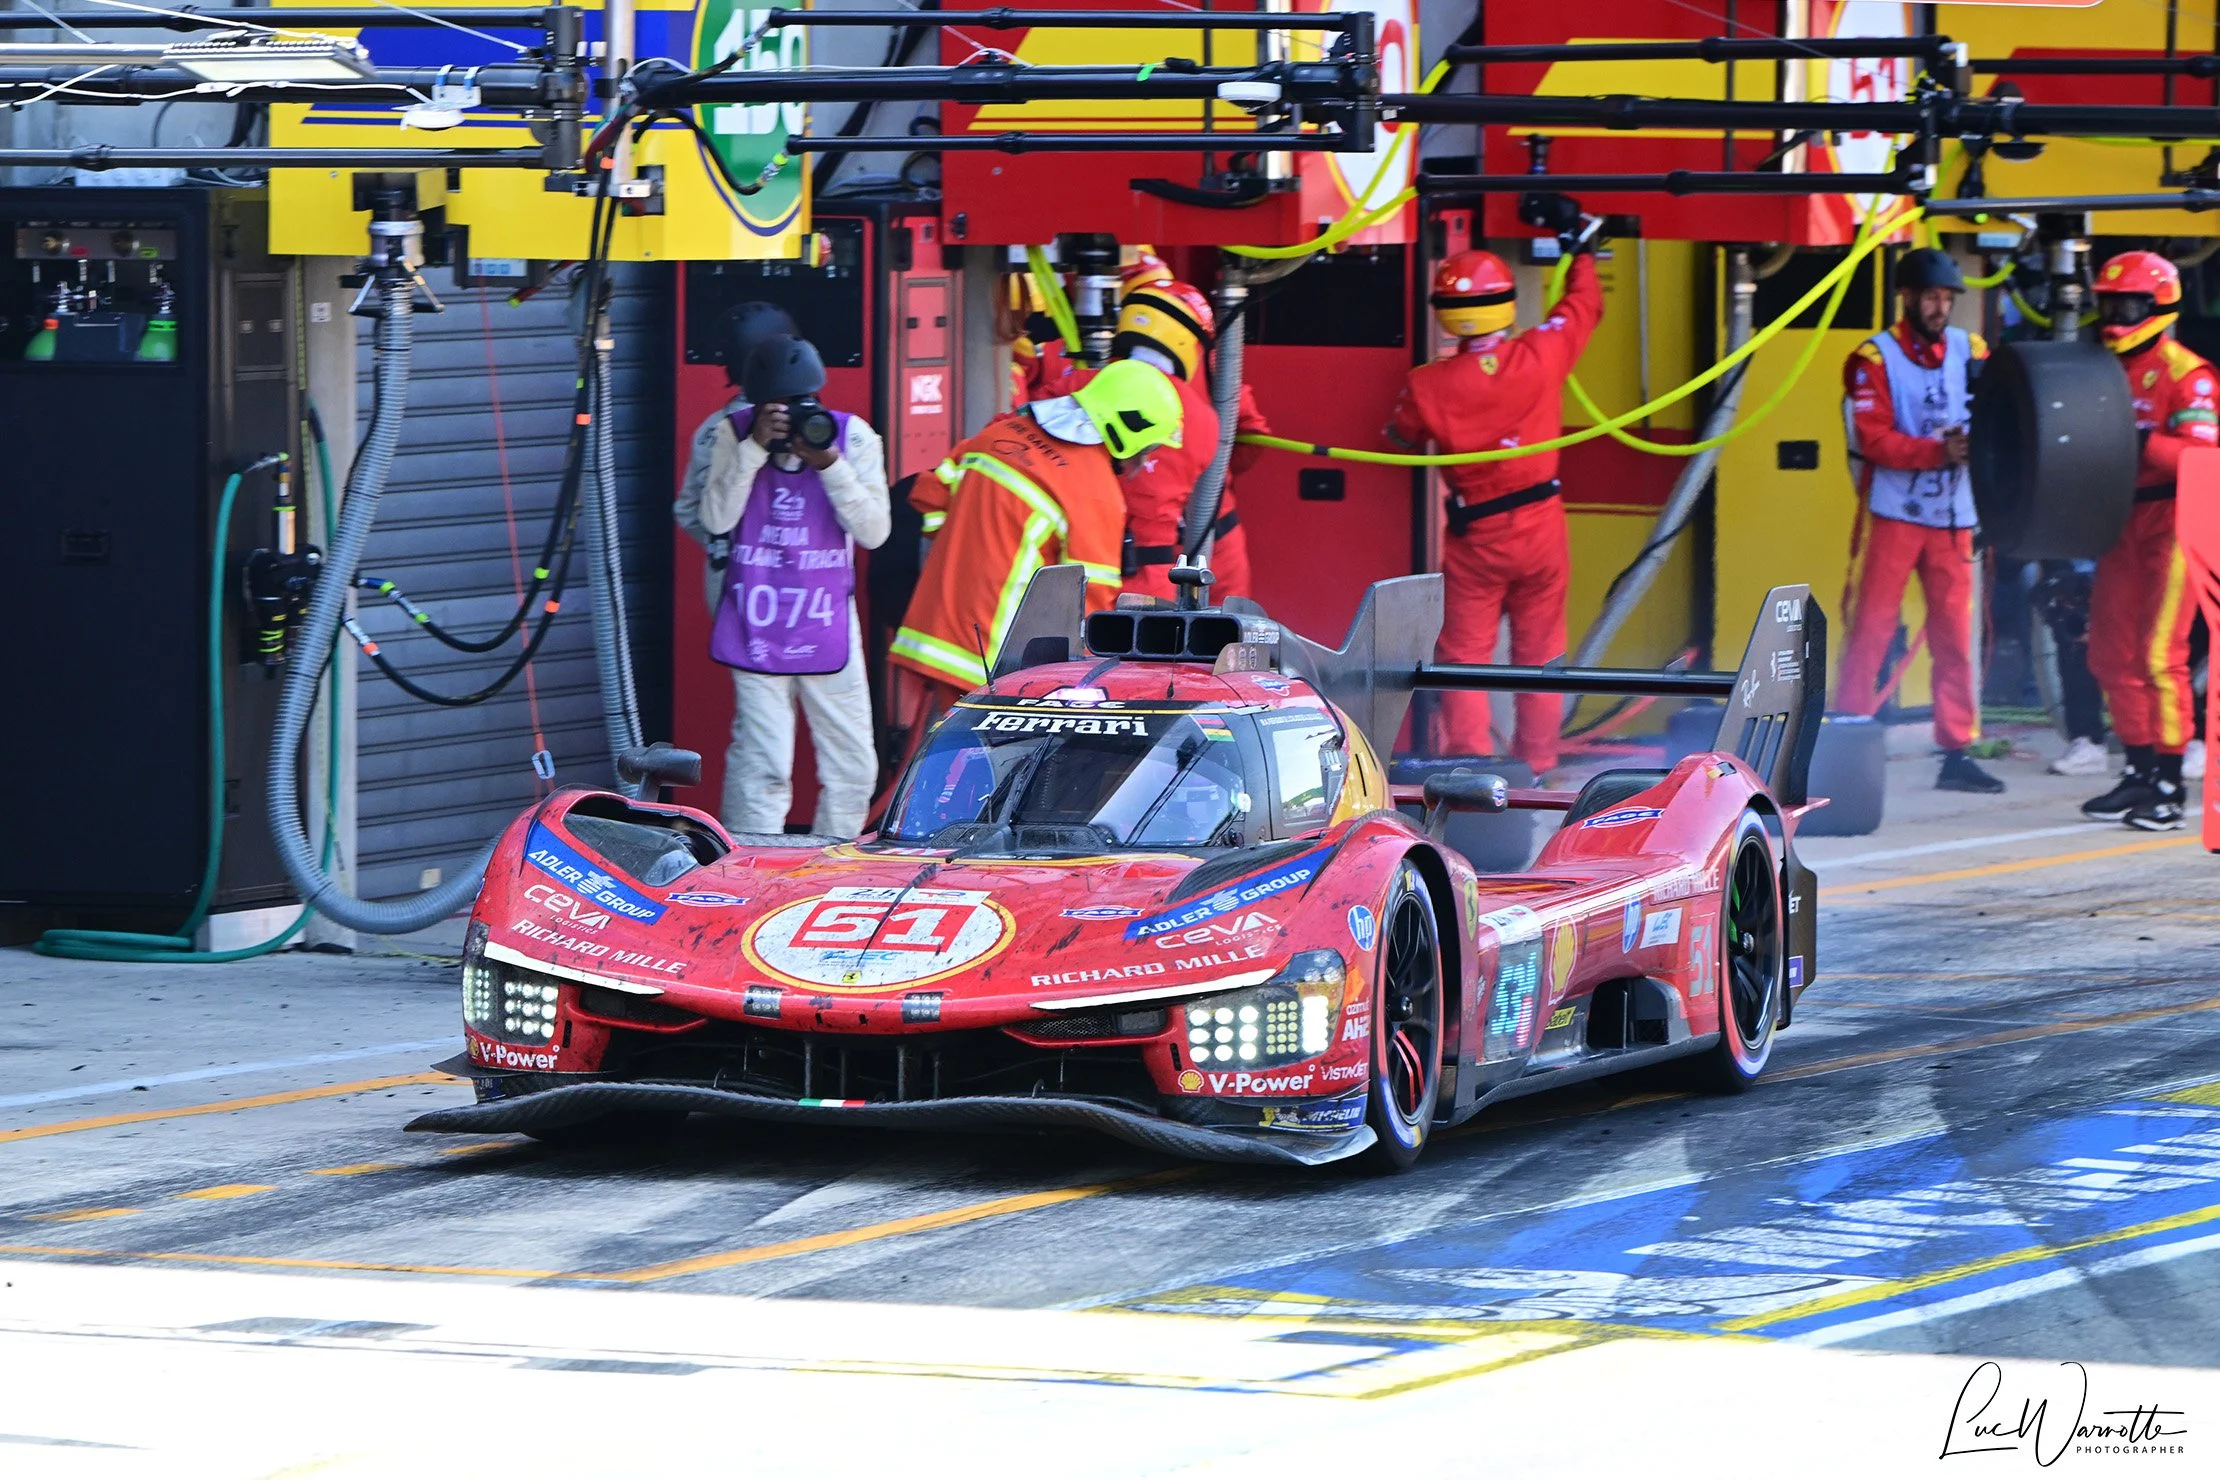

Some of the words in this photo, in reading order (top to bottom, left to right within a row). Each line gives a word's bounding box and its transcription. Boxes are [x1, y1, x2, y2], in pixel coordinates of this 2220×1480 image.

[759, 524, 810, 547] MEDIA
[732, 582, 835, 629] 1074
[971, 711, 1149, 736] Ferrari
[528, 849, 583, 884] ADLER
[595, 890, 656, 918] GROUP
[1137, 907, 1213, 936] ADLER
[1240, 869, 1311, 901] GROUP
[511, 918, 611, 957] RICHARD
[608, 950, 688, 974] MILLE
[550, 915, 598, 935] LOGISTICS
[802, 905, 950, 946] 51
[1215, 924, 1282, 946] LOGISTICS
[1353, 906, 1373, 949] hp
[1031, 961, 1165, 987] RICHARD
[1175, 944, 1265, 970] MILLE
[1688, 923, 1714, 998] 51
[480, 1042, 558, 1069] V-Power
[1208, 1070, 1314, 1095] V-Power
